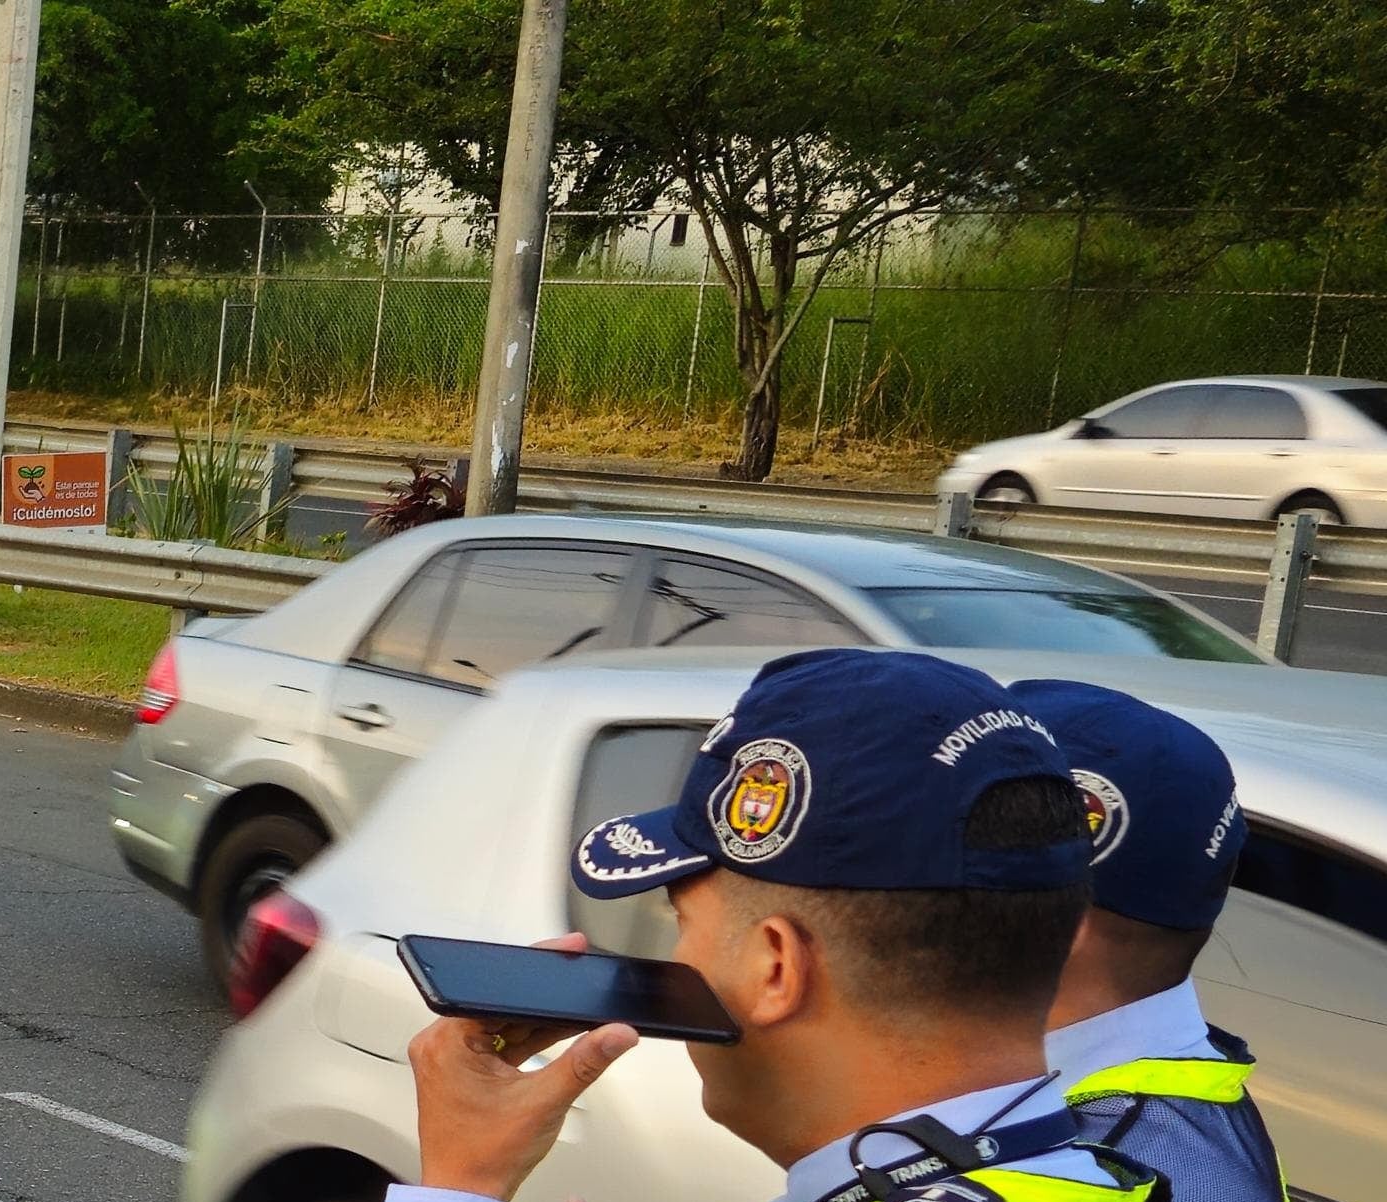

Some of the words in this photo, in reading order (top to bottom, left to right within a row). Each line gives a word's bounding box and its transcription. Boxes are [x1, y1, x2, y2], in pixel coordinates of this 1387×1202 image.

[55, 481, 72, 490] Este
[72, 481, 100, 491] parque
[55, 492, 65, 500] es
[65, 491, 76, 499] de
[76, 490, 98, 498] todos
[931, 709, 1023, 767] MOVILIDAD
